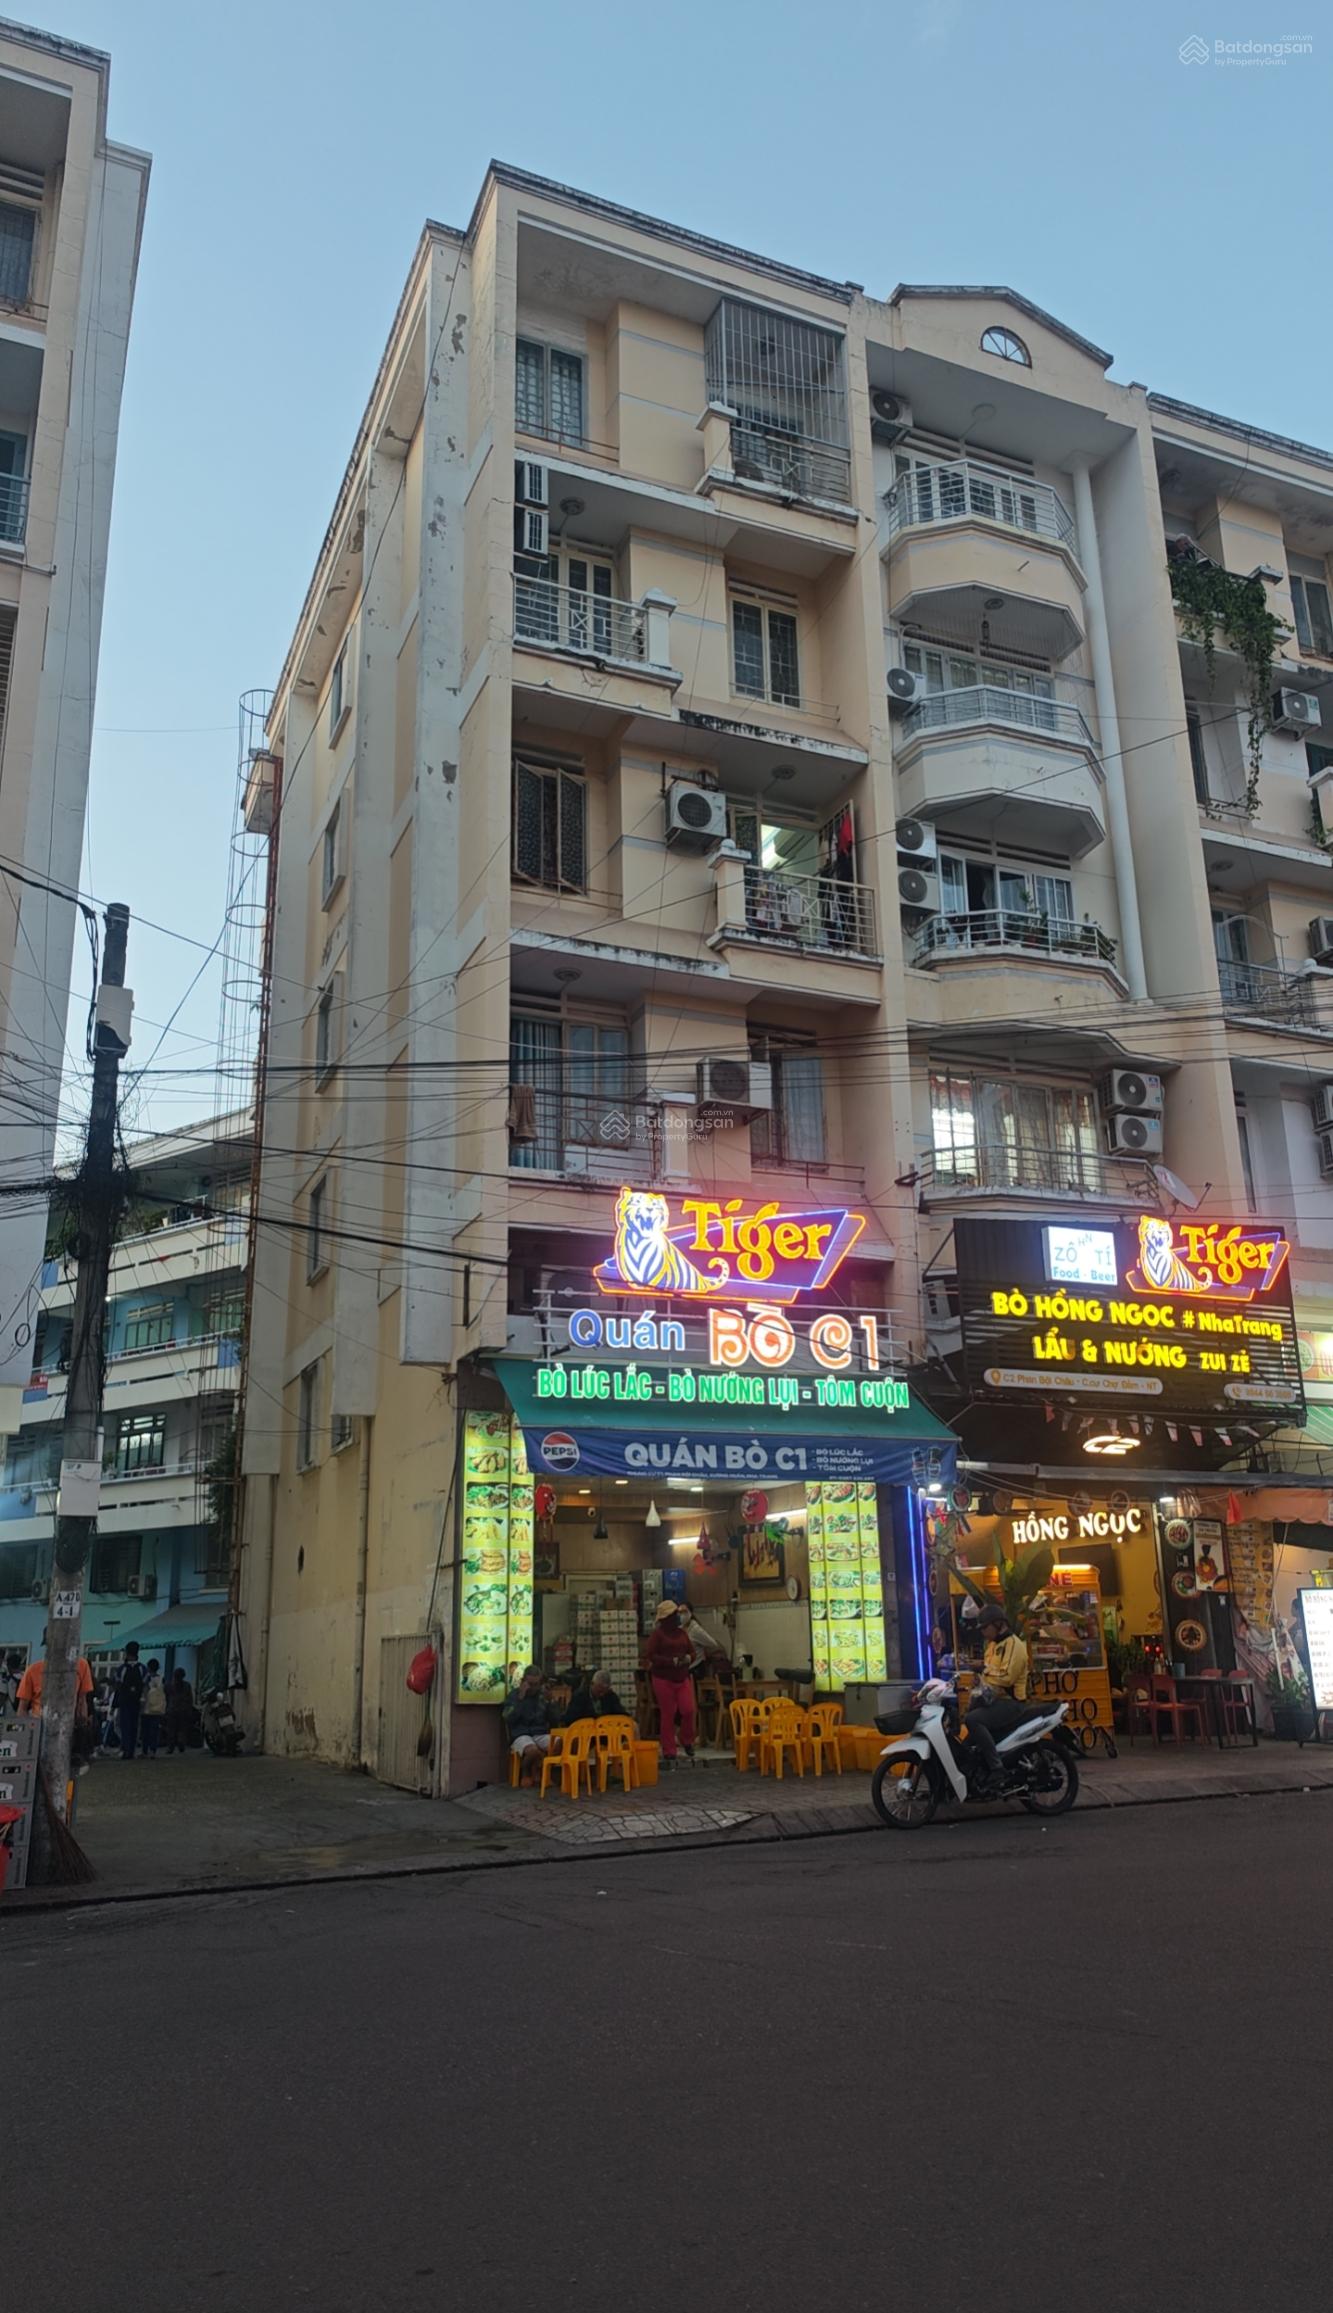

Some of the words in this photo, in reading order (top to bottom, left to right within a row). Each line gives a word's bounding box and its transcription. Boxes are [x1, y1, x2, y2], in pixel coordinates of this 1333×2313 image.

[681, 1198, 832, 1282] Tiger
[1180, 1224, 1277, 1285] Tiger
[1053, 1266, 1080, 1279] Food
[1090, 1269, 1115, 1282] Beer
[991, 1287, 1028, 1317] BÒ
[1034, 1287, 1103, 1323] HỒNG
[568, 1308, 685, 1351] Quán
[809, 1313, 880, 1371] C1
[1032, 1326, 1076, 1360] LẨU
[1081, 1339, 1098, 1362] &
[1104, 1337, 1187, 1368] NƯỚNG
[1200, 1351, 1227, 1371] ZUI
[537, 1362, 567, 1398] BÒ
[571, 1364, 610, 1399] LÚC
[613, 1362, 652, 1400] LẮC
[668, 1368, 696, 1402] BÒ
[698, 1370, 765, 1404] NƯỚNG
[768, 1377, 799, 1411] LỤI
[814, 1374, 857, 1407] TÔM
[860, 1375, 910, 1414] CUỘN
[543, 1446, 577, 1456] PEPSI
[624, 1436, 718, 1469] QUÁN
[724, 1439, 768, 1470] BÒ
[774, 1446, 808, 1471] C1
[1011, 1511, 1069, 1544] HỒNG
